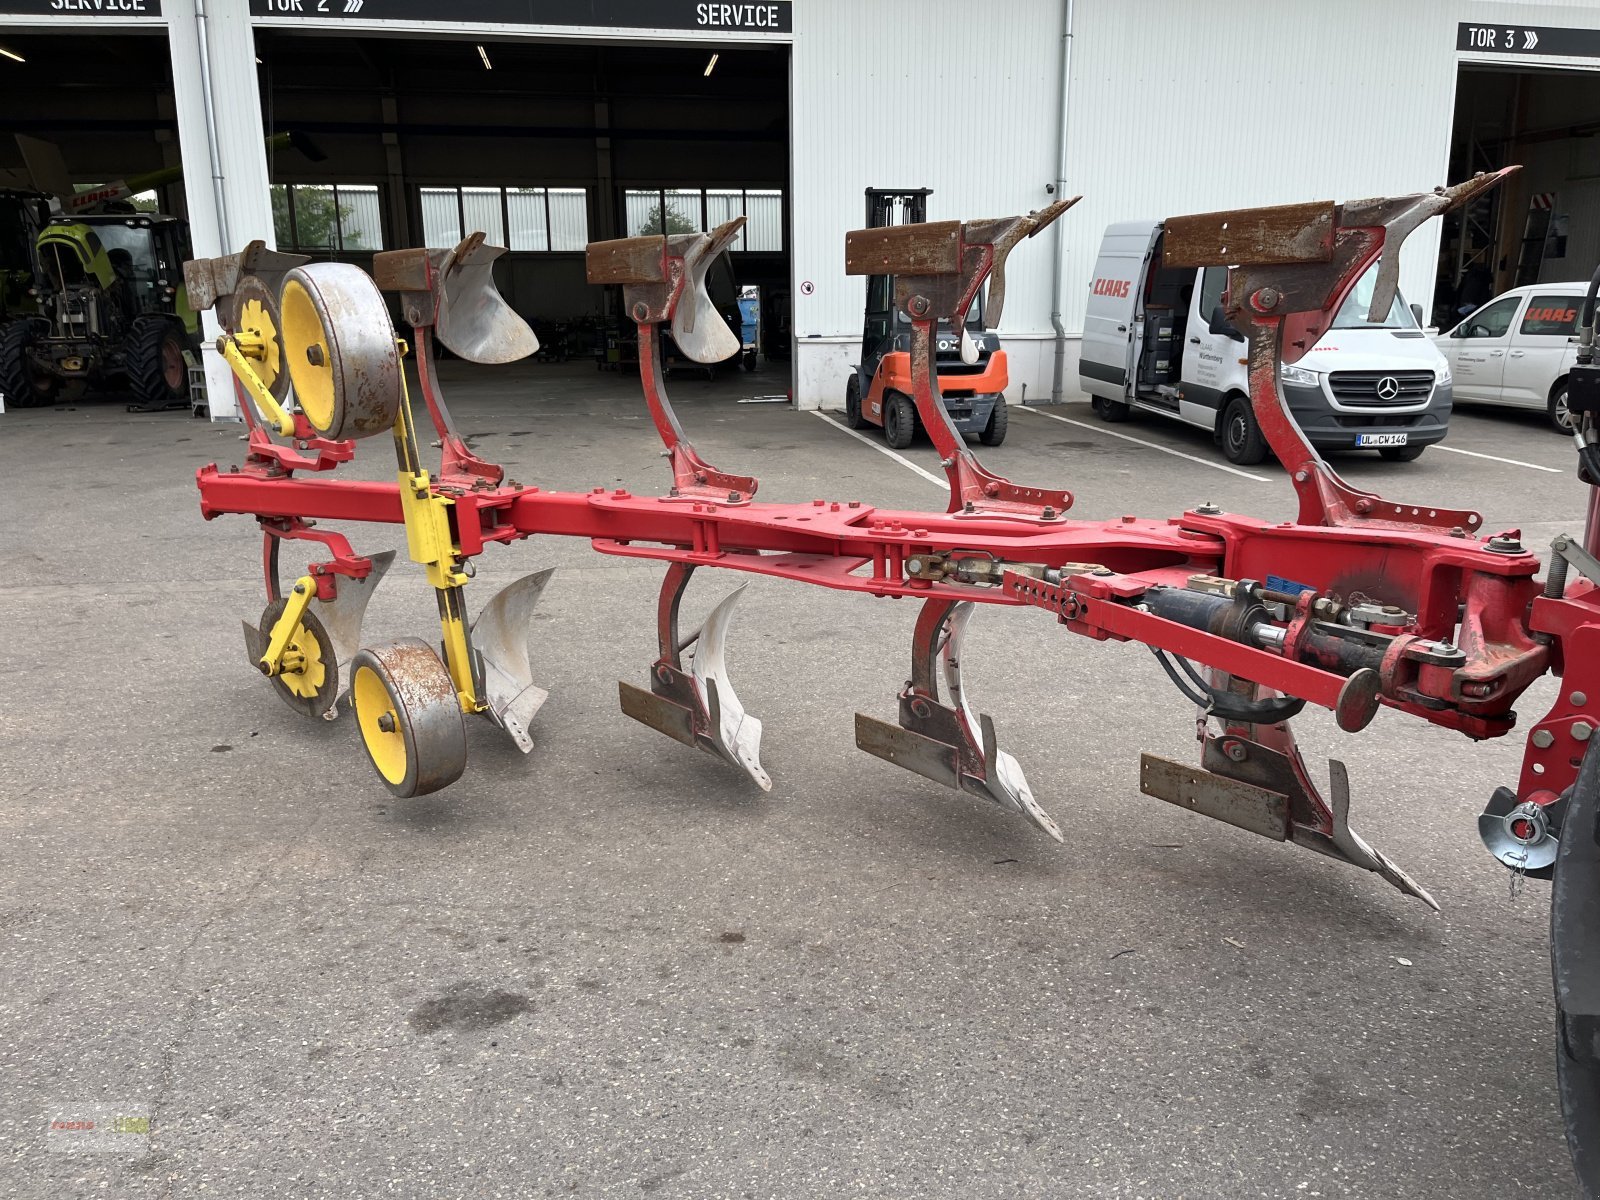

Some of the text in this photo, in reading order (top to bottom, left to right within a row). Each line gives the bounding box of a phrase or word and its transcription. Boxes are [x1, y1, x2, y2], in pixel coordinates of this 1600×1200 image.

[696, 3, 779, 27] SERVICE
[1468, 27, 1516, 49] TOR 3
[72, 186, 119, 208] CLAAS
[1093, 278, 1131, 298] CLAAS
[1524, 306, 1577, 322] CLAAS
[1361, 434, 1406, 445] UL CW 146
